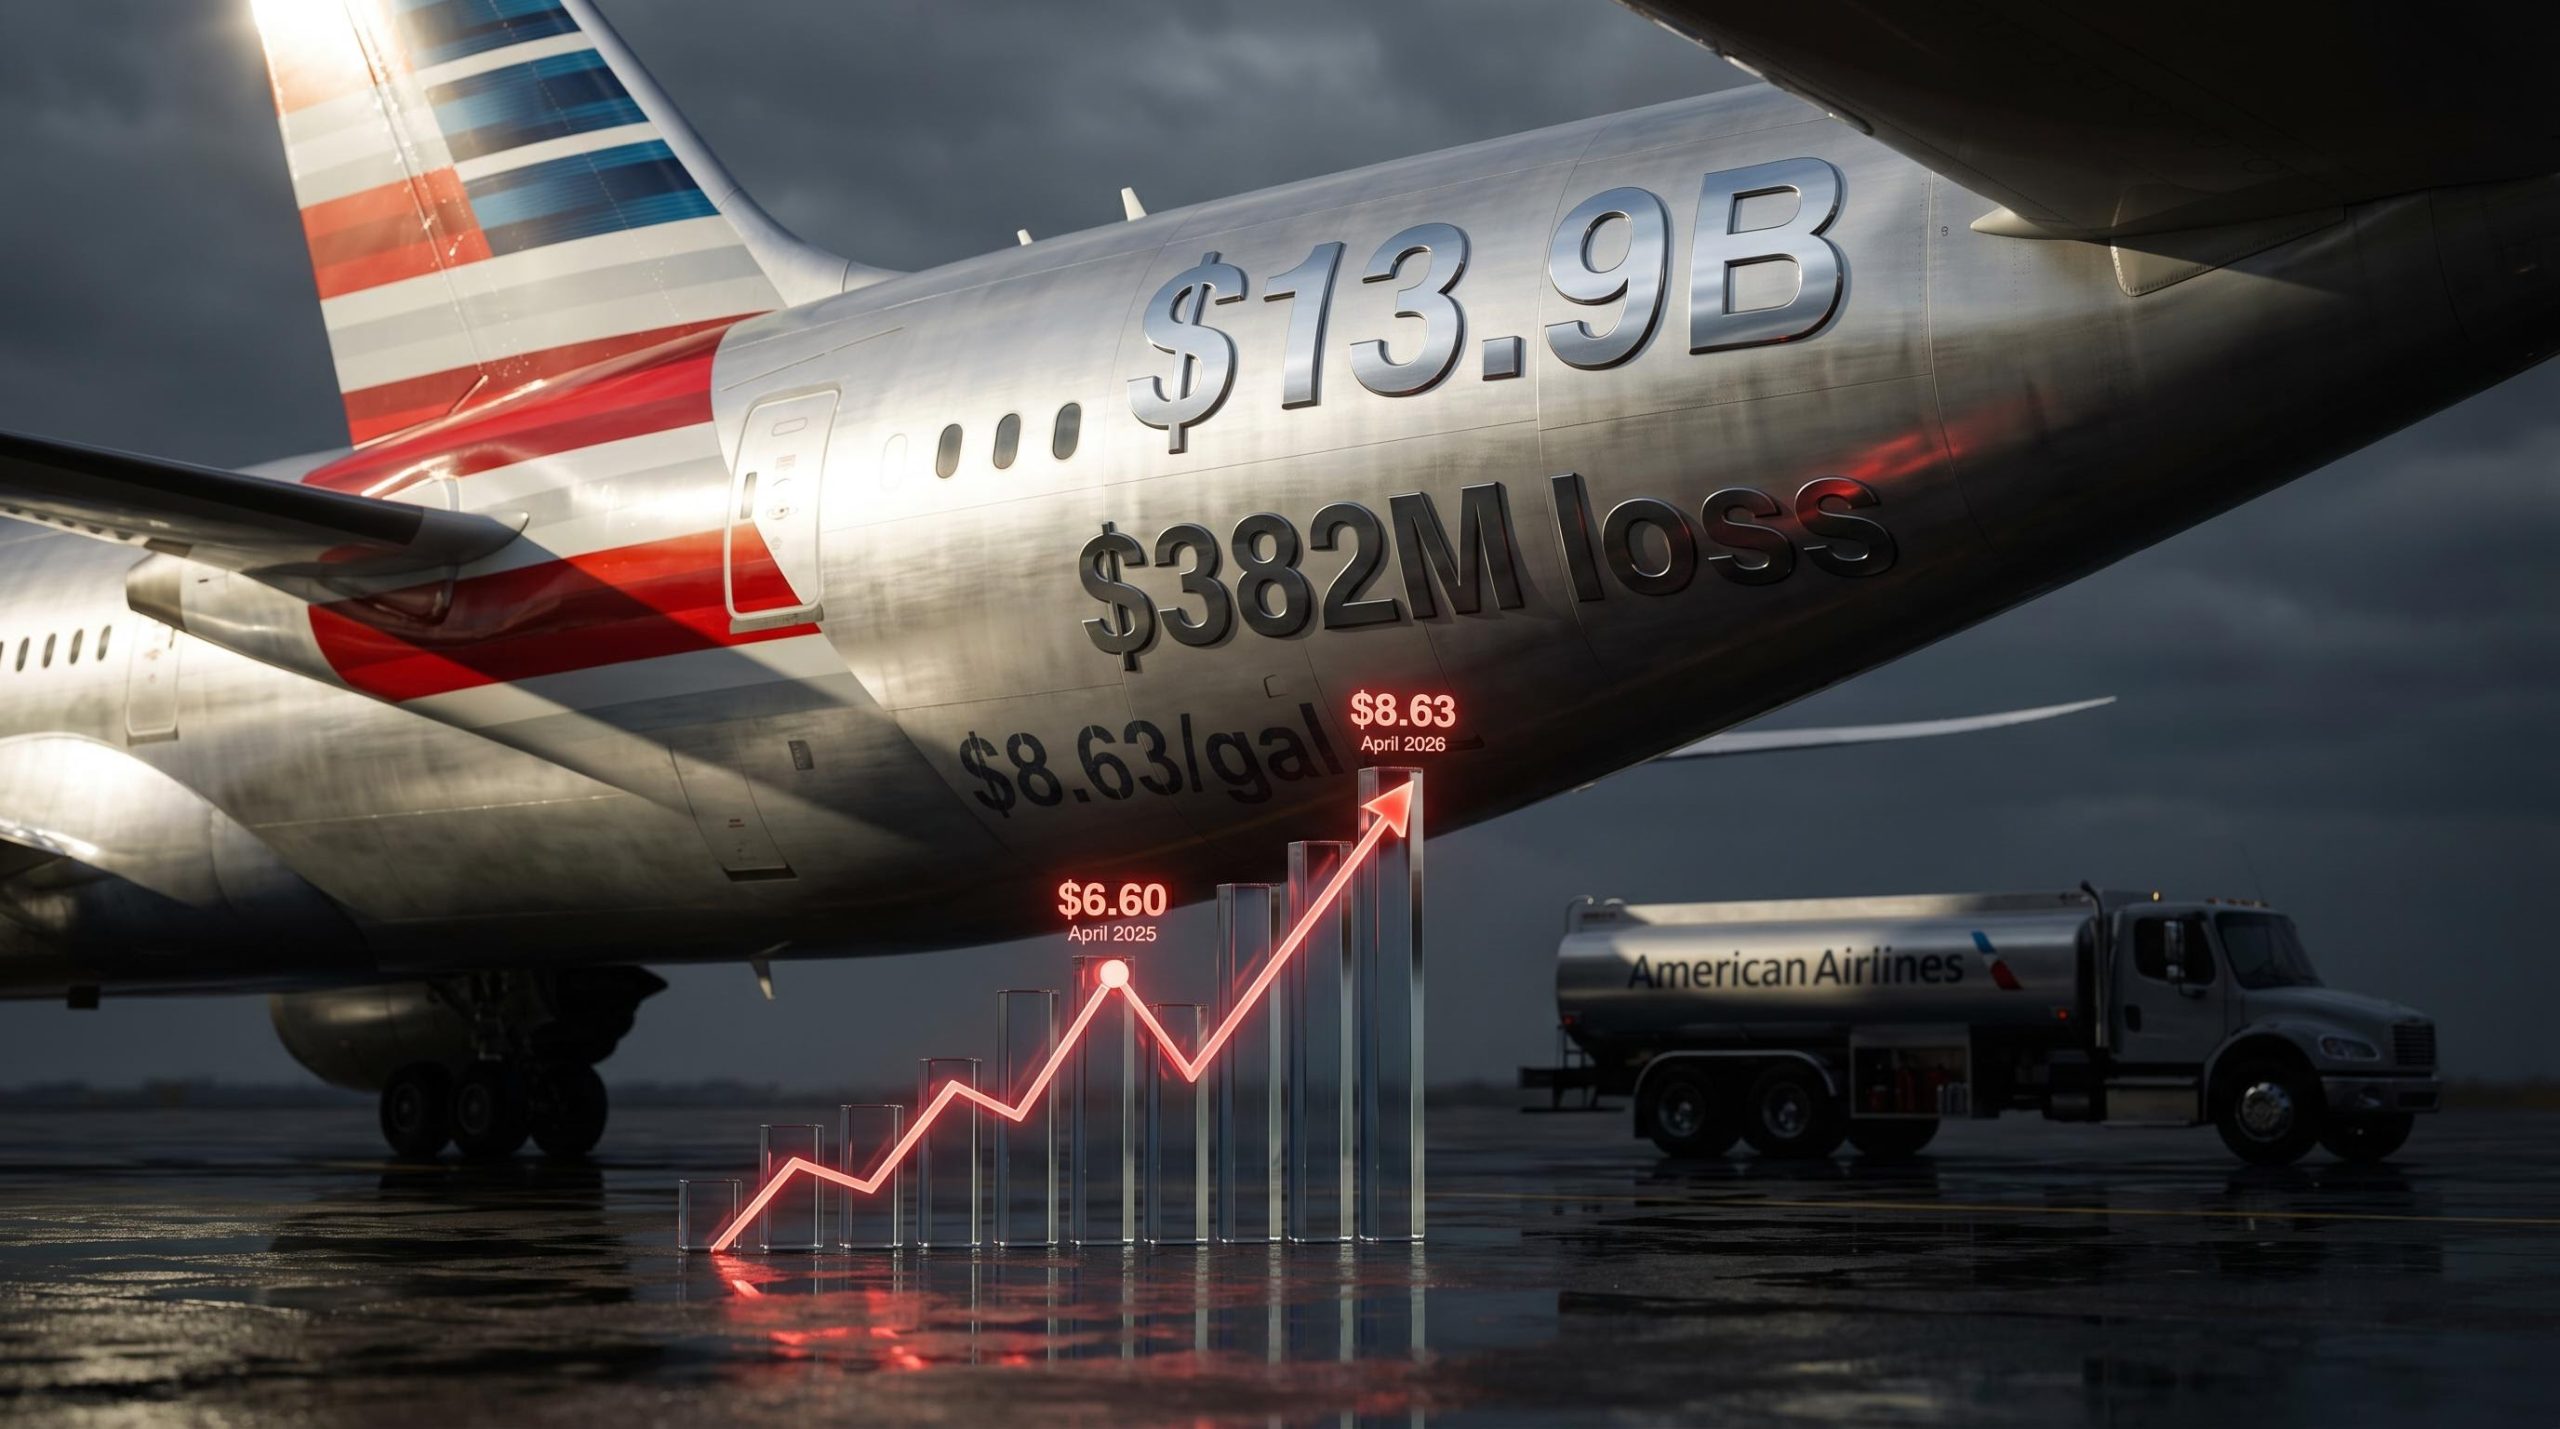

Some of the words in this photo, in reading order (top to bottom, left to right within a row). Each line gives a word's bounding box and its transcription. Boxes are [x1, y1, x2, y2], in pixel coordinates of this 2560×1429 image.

[1127, 156, 1847, 454] $13.9B
[1078, 479, 1525, 672] $382M
[1550, 472, 1898, 601] loss
[959, 702, 1344, 818] $8.63/gal
[1627, 951, 1806, 989] American
[1813, 946, 1964, 985] Airlines
